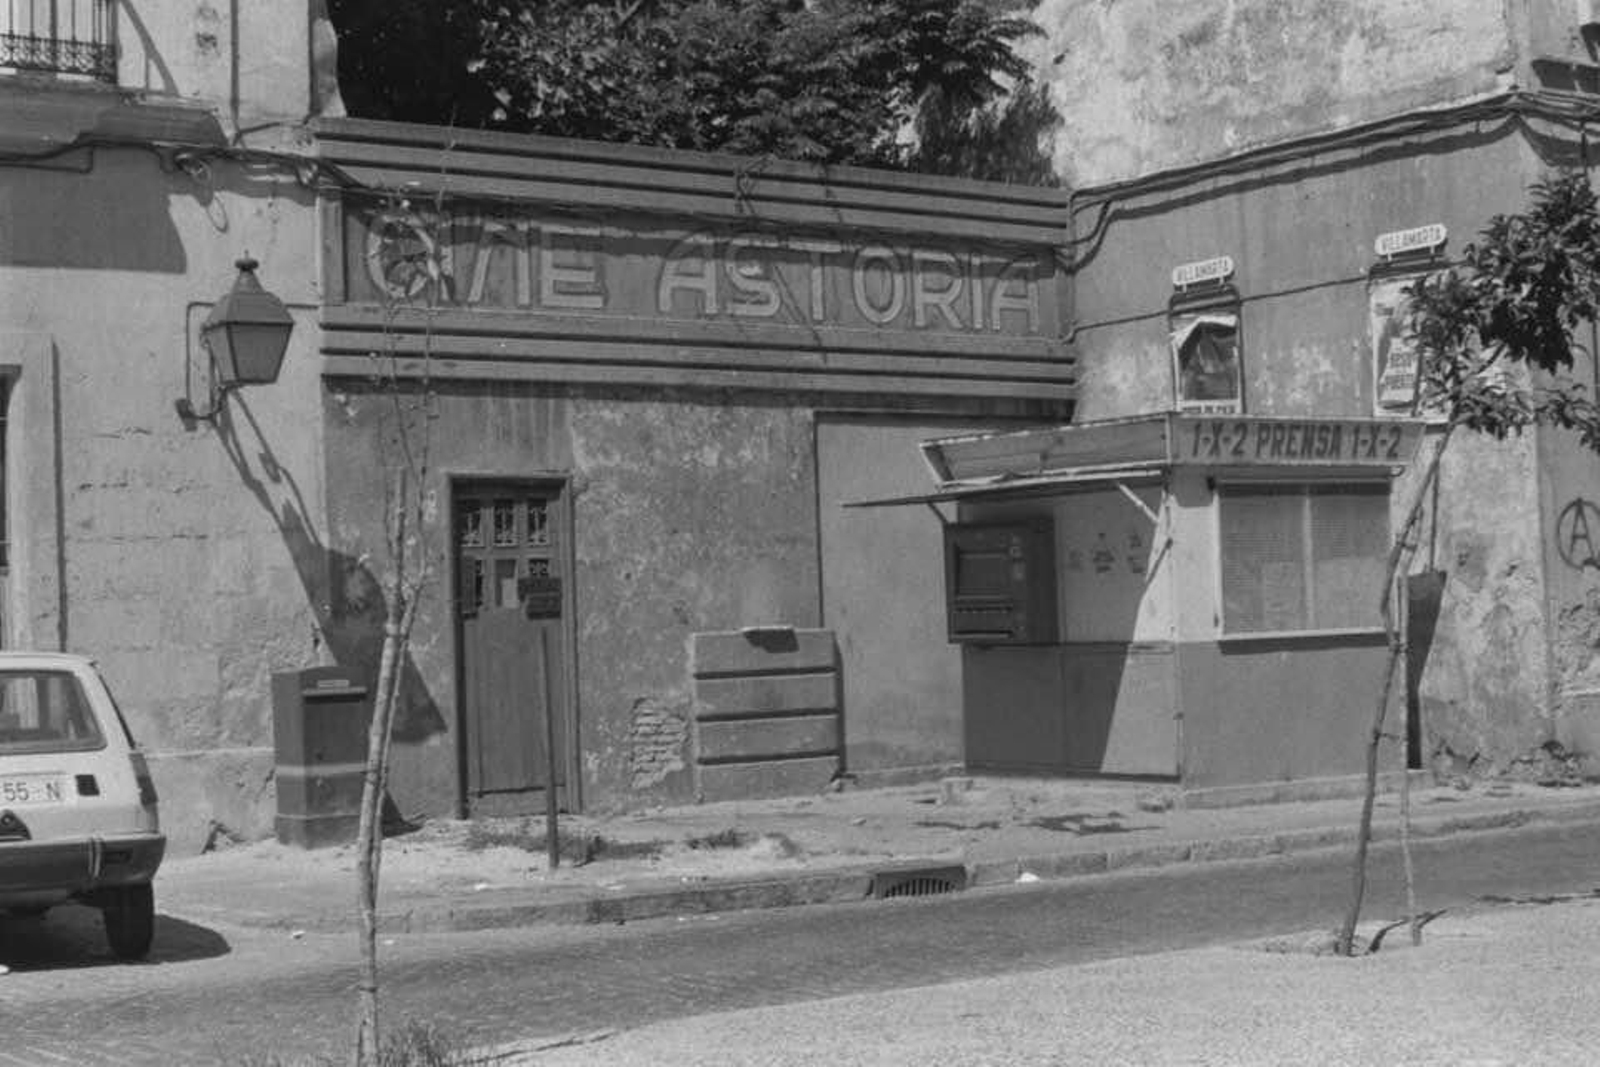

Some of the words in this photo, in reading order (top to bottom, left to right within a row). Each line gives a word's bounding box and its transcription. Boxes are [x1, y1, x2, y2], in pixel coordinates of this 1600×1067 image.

[659, 235, 1041, 333] ASTORIA
[1192, 421, 1249, 458] 1-X-2
[1254, 423, 1344, 460] PRENSA
[1352, 424, 1402, 460] 1-X-2
